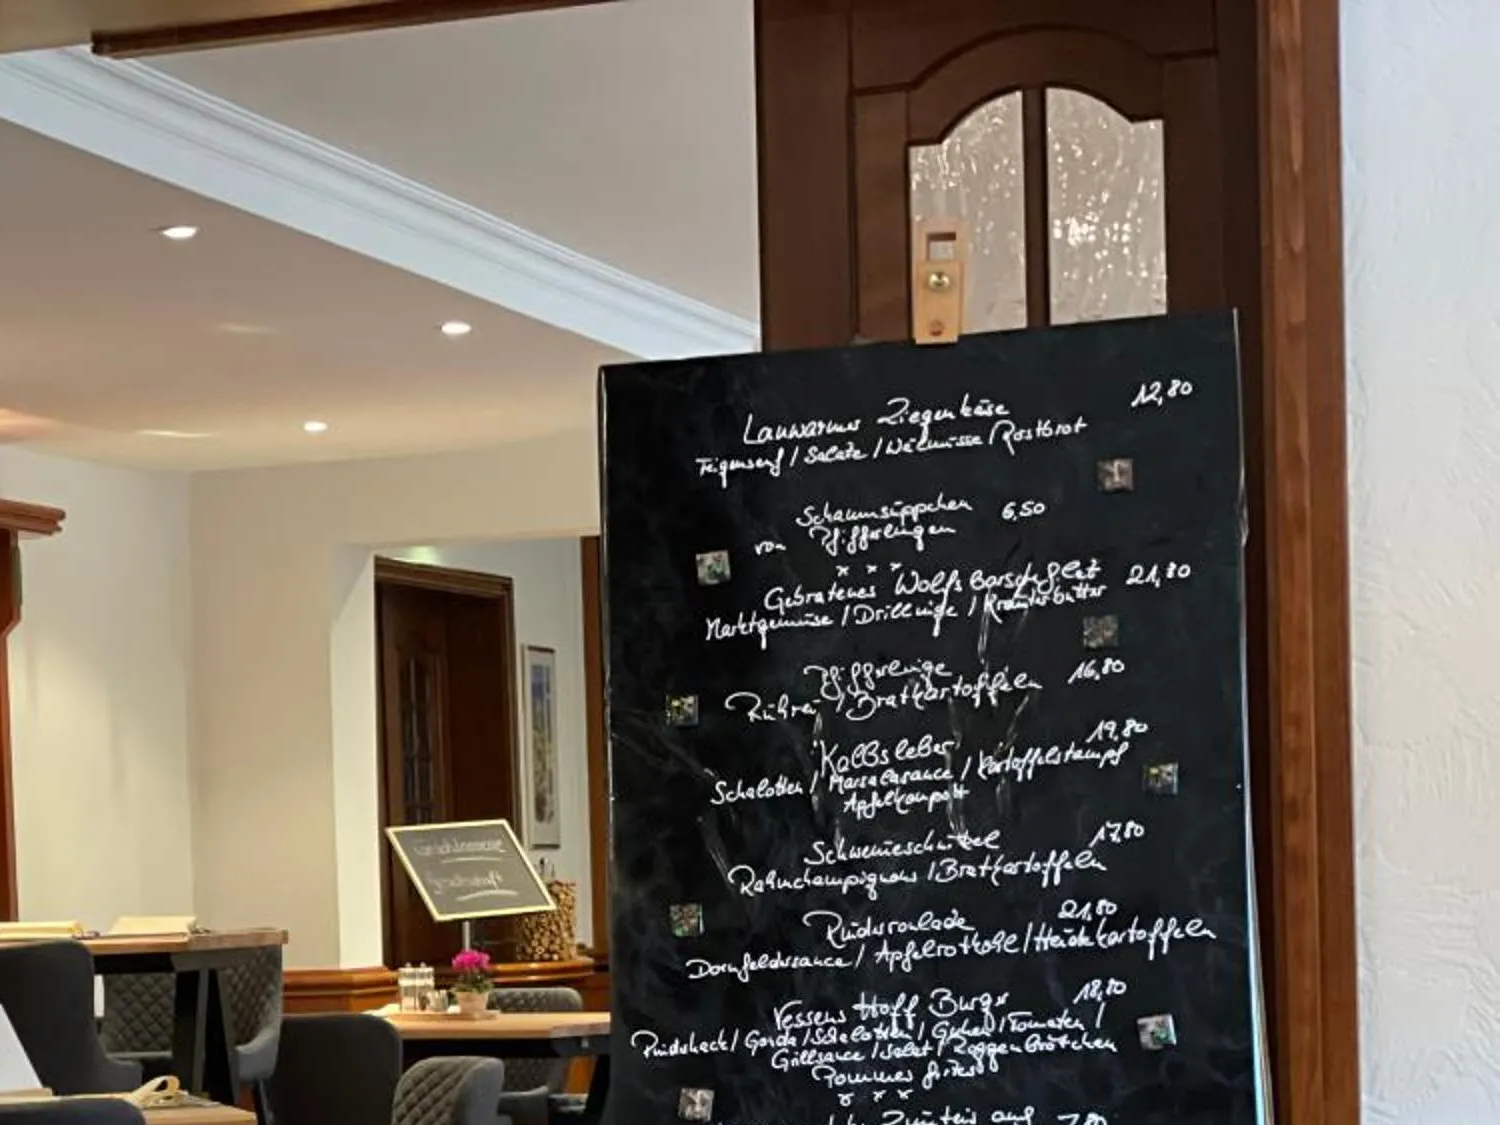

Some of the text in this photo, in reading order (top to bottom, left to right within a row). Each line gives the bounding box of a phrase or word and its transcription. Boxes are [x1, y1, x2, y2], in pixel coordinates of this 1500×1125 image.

[1130, 379, 1193, 407] 12,80
[804, 442, 869, 464] Salate
[1001, 501, 1046, 521] 6,50
[754, 541, 787, 555] von
[1067, 657, 1125, 684] 16,80
[1085, 718, 1149, 743] 19,80
[1088, 820, 1145, 848] 17,80
